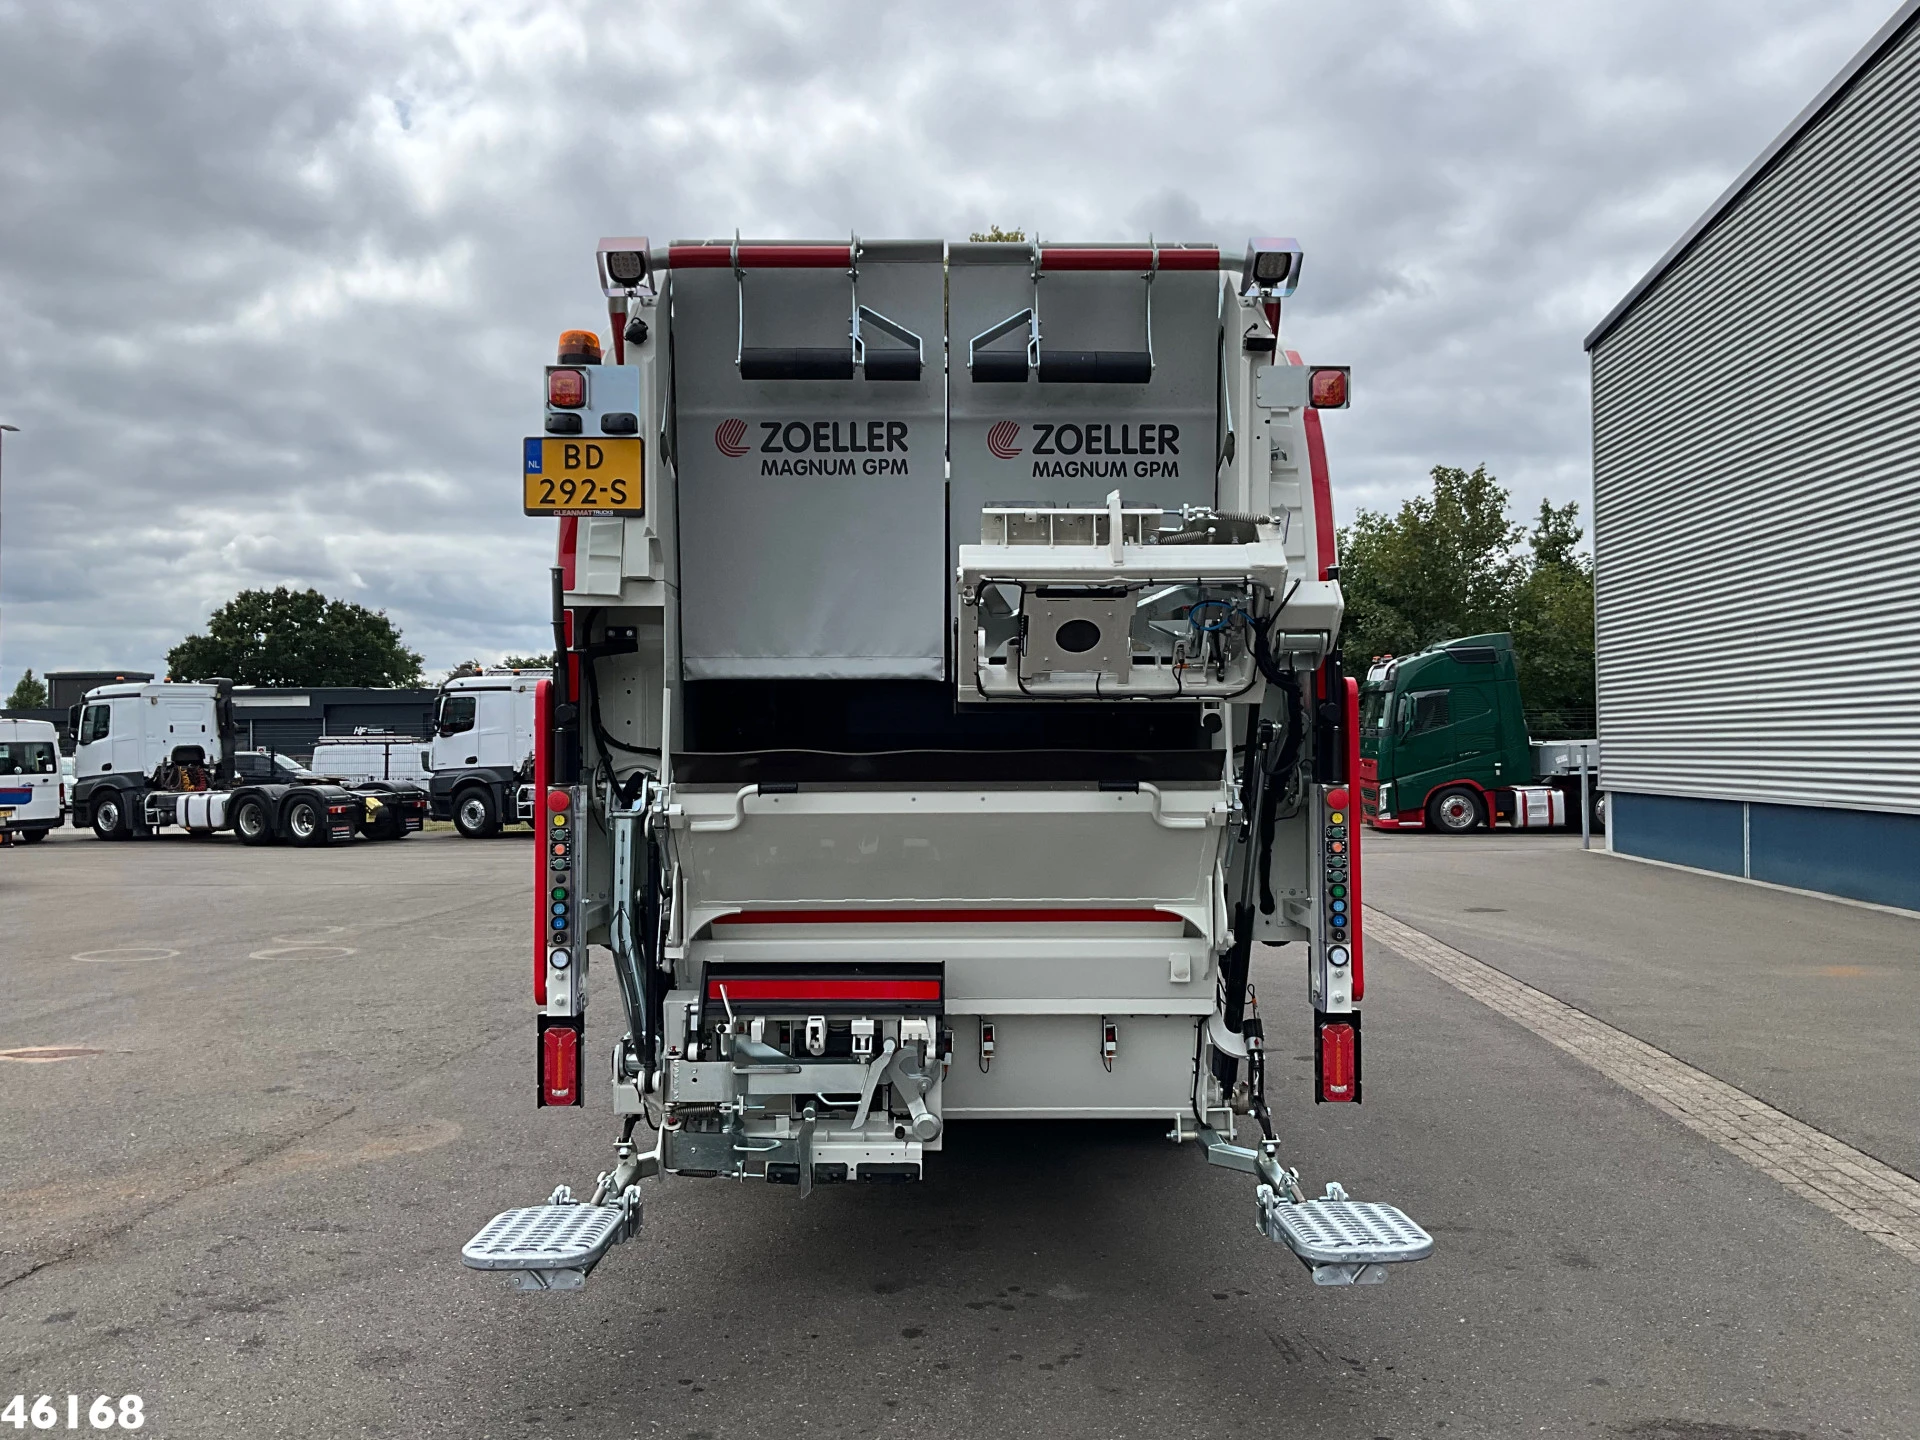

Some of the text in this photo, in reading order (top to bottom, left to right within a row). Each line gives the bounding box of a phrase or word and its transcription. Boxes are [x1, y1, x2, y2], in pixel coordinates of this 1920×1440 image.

[760, 421, 909, 453] ZOELLER
[1032, 423, 1180, 455] ZOELLER
[528, 460, 540, 469] NL
[564, 444, 604, 470] BD
[761, 458, 909, 476] MAGNUM GPM
[1032, 460, 1180, 478] MAGNUM GPM
[539, 478, 628, 505] 292-S
